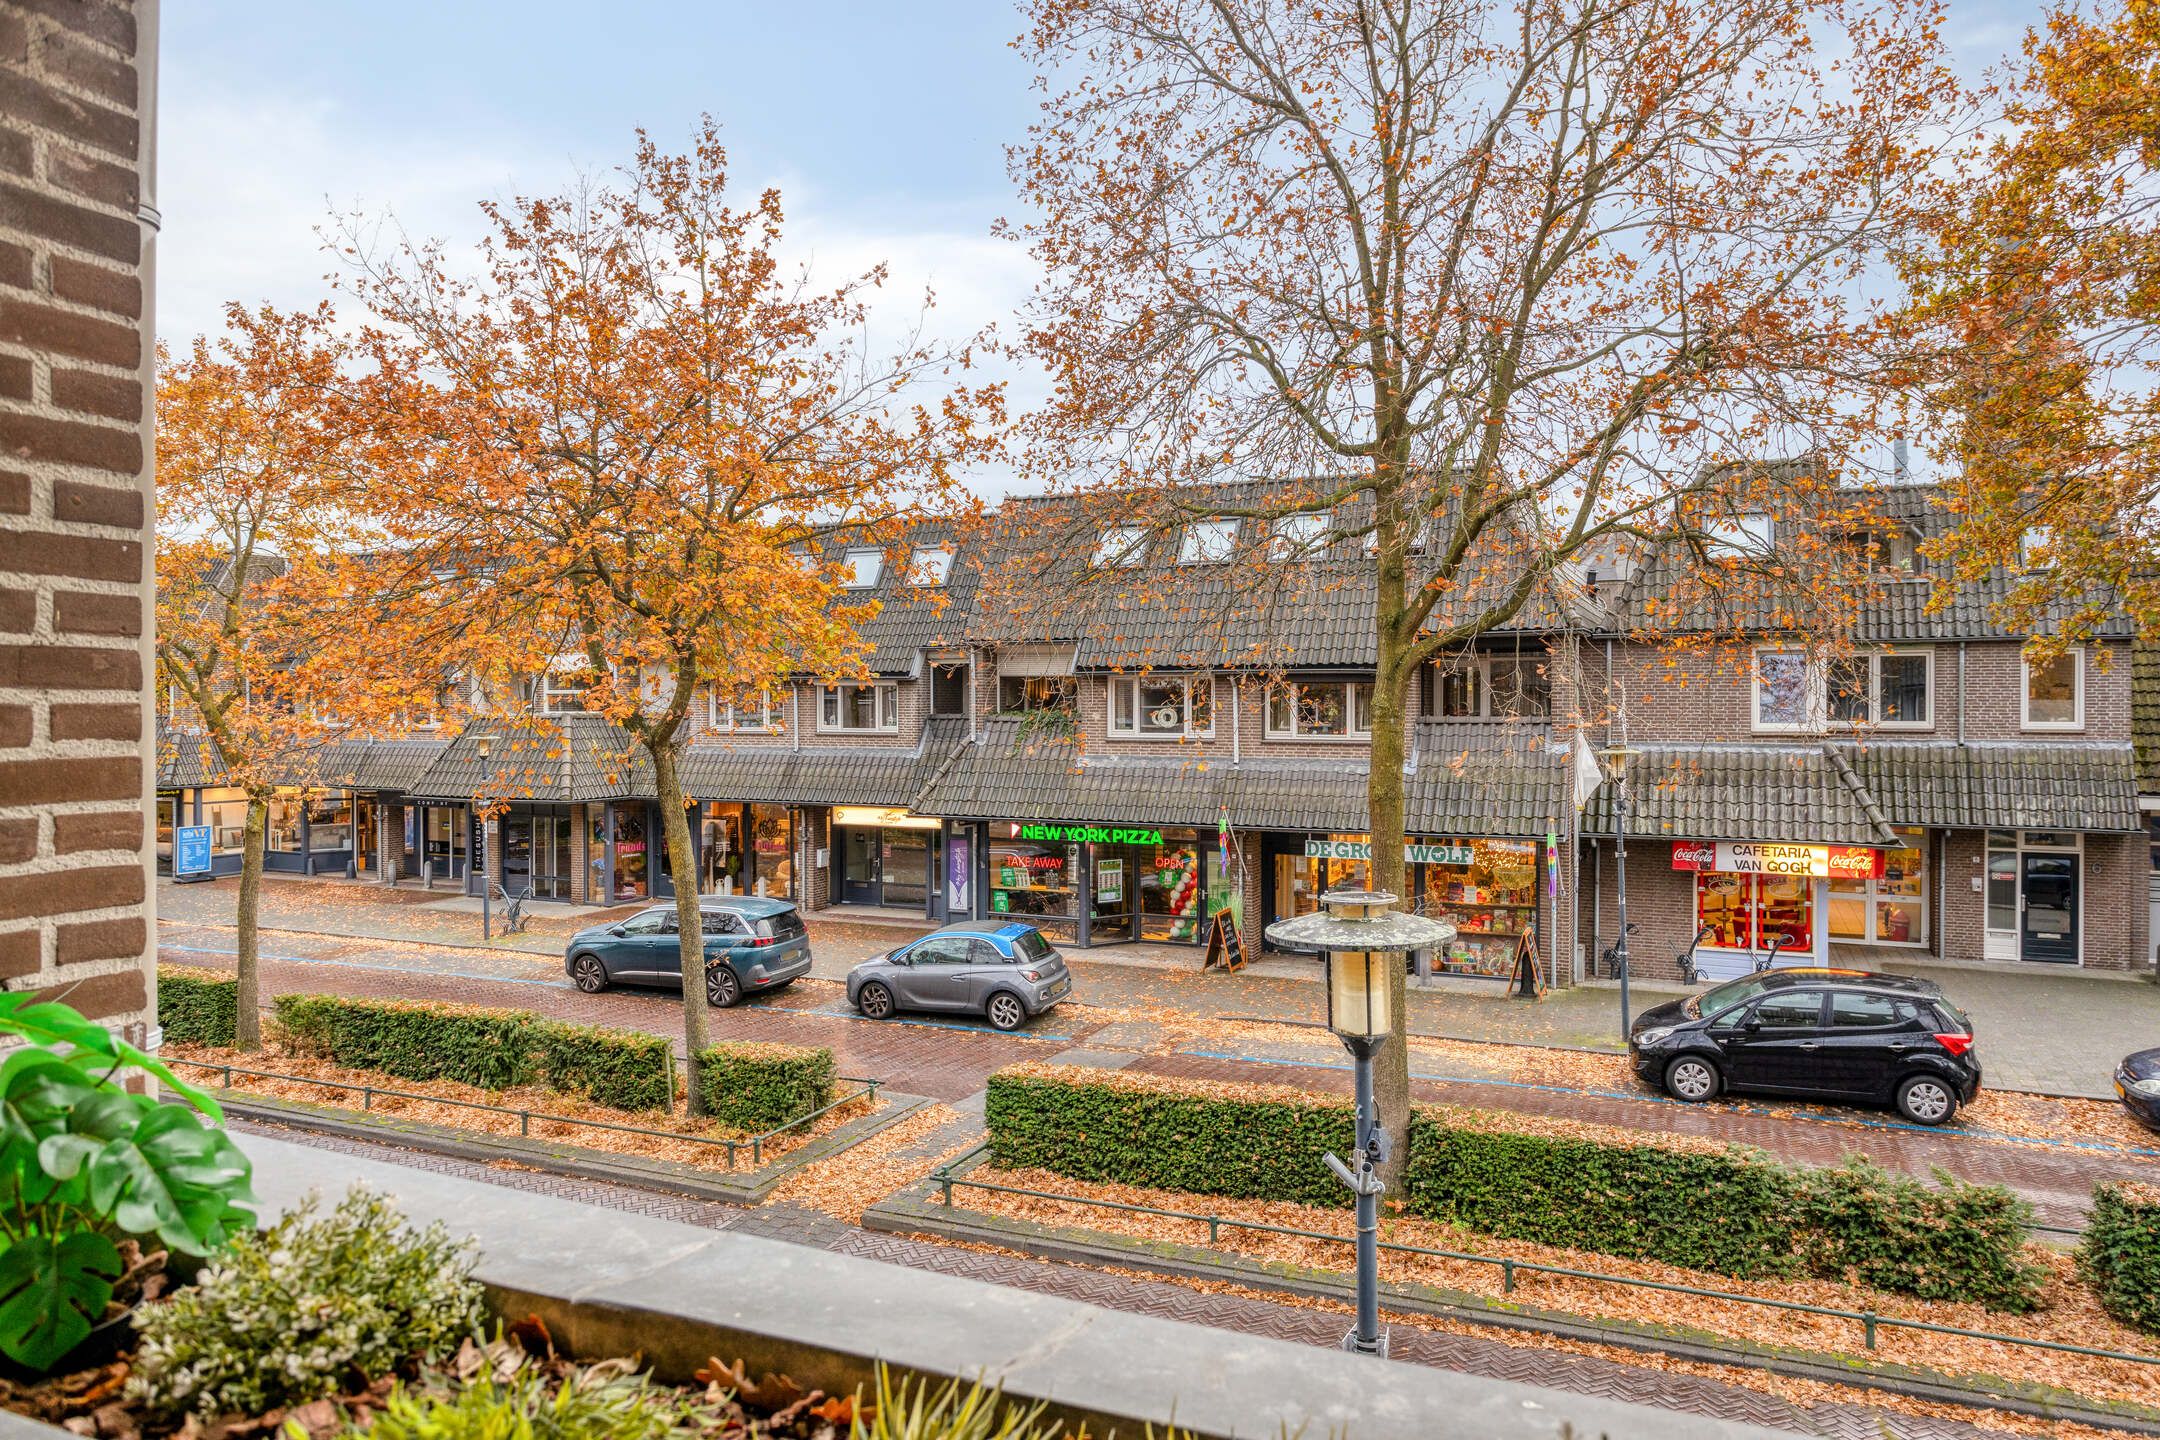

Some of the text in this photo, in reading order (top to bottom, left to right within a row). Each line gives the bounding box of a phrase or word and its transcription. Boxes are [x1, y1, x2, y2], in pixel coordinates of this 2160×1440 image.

[1022, 825, 1164, 845] NEW YORK PIZZA
[1307, 840, 1331, 857] DE
[1408, 845, 1473, 863] WOLF
[1732, 844, 1812, 859] CAFETARIA
[1006, 855, 1063, 869] TAKE AWAY
[1155, 857, 1185, 869] OPEN
[1734, 859, 1812, 874] VAN GOGH
